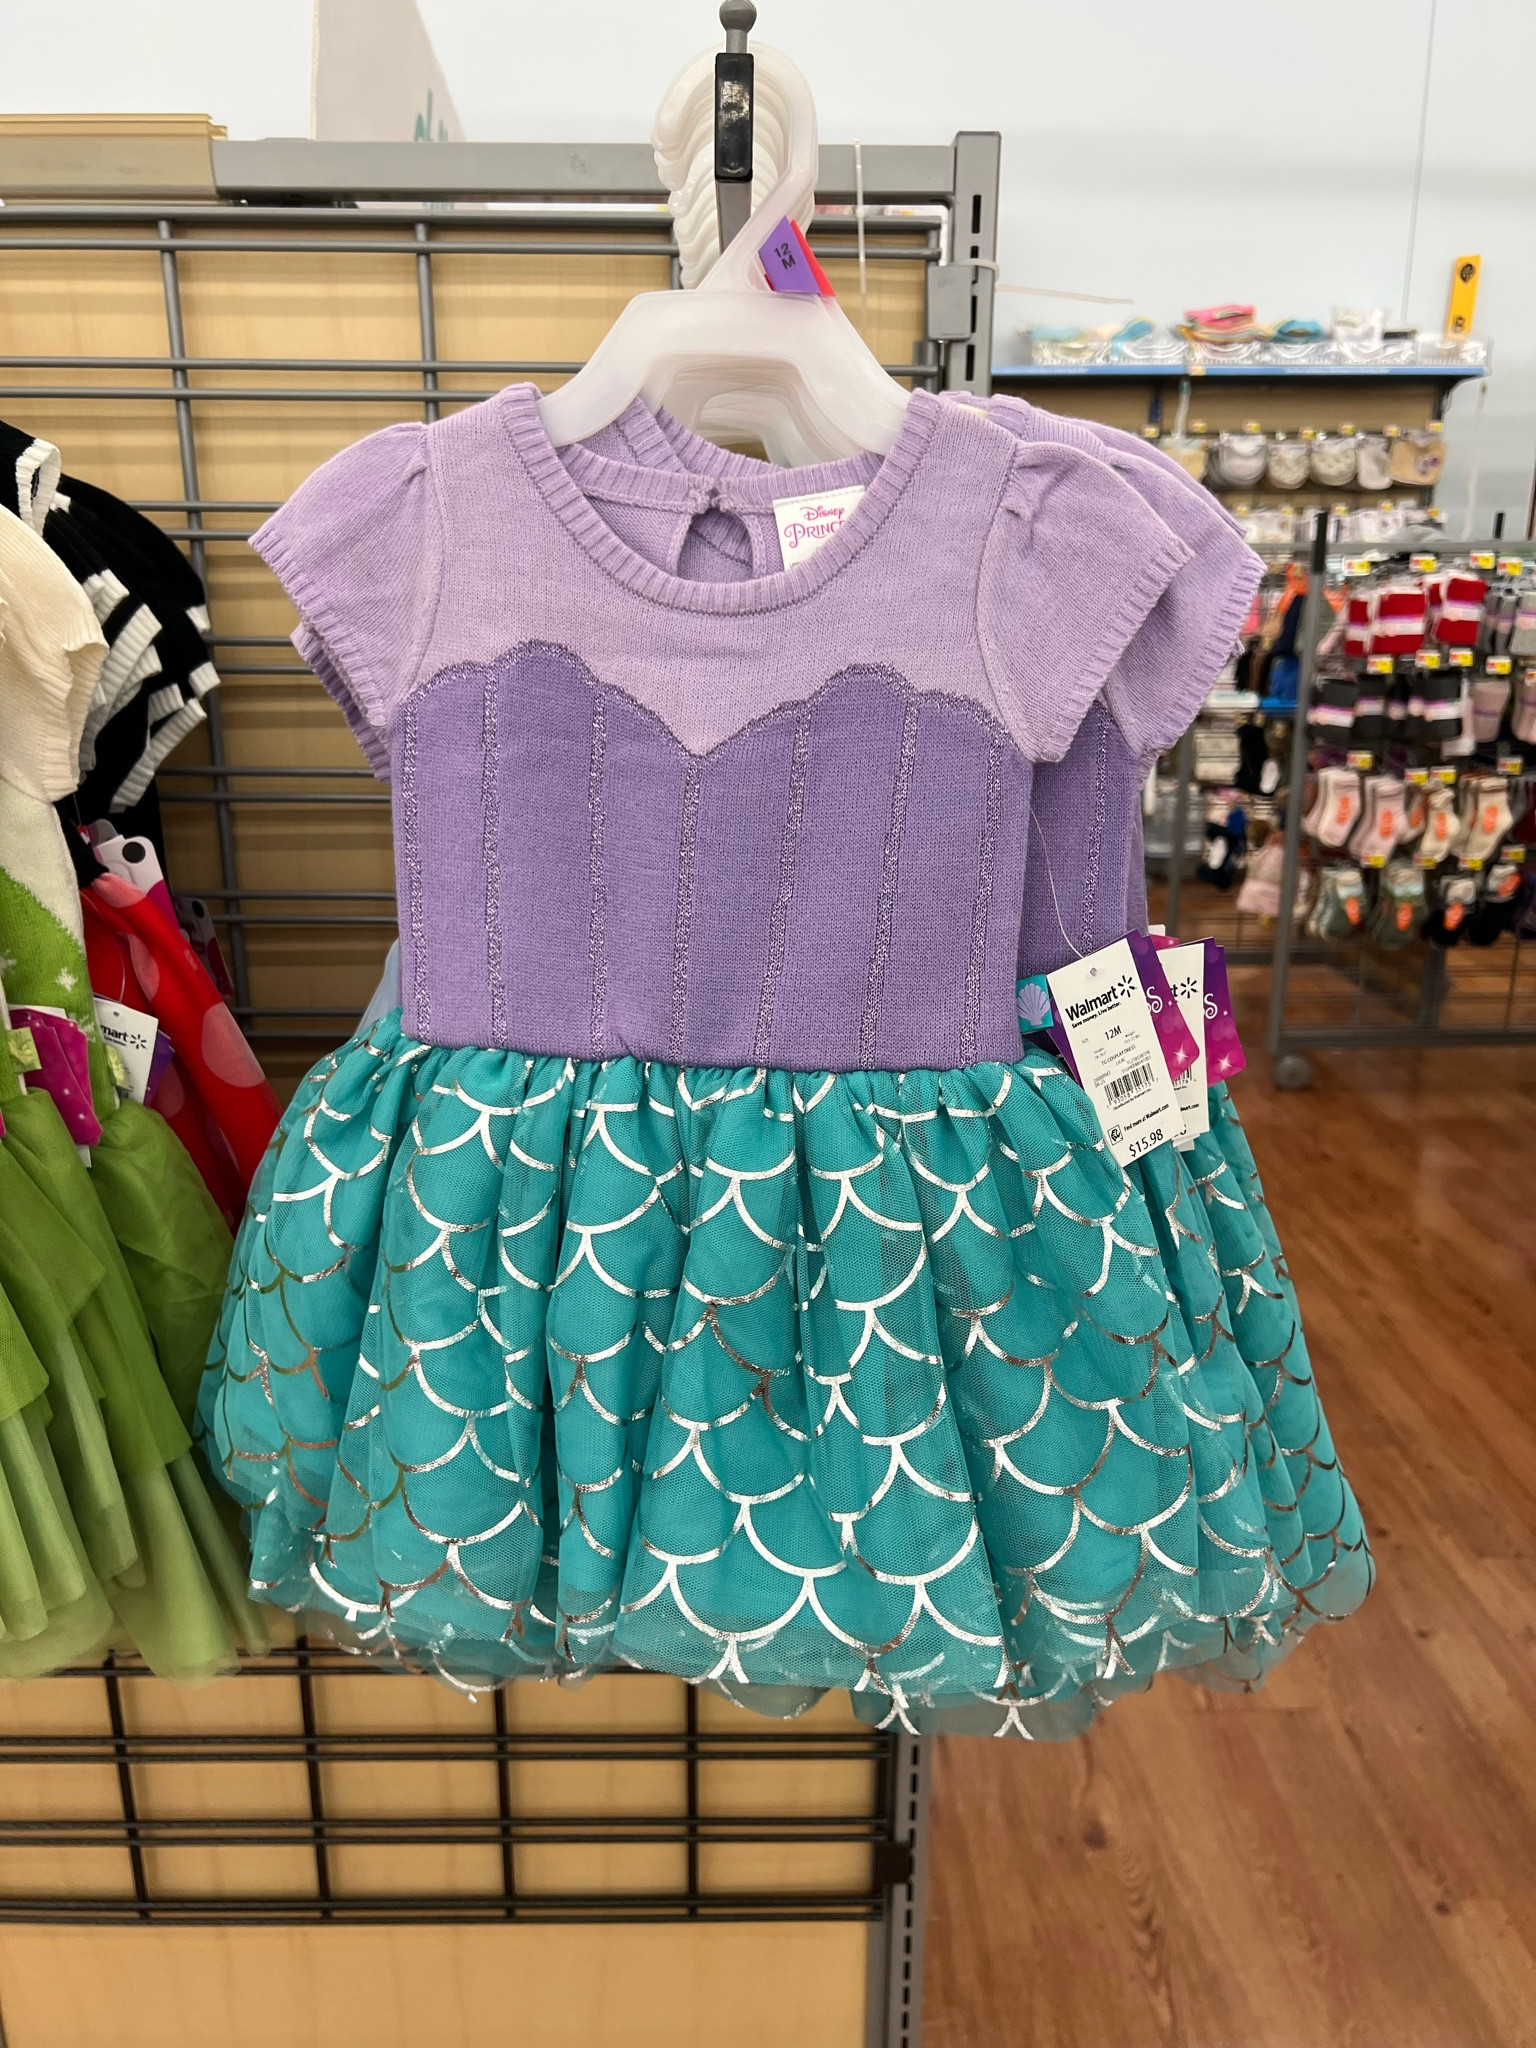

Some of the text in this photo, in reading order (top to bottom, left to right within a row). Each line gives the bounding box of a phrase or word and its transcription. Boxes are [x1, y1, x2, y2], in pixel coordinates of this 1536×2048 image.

[773, 242, 791, 258] 12
[781, 254, 796, 270] M
[800, 505, 845, 521] Disney
[783, 520, 846, 549] PRINC
[1064, 985, 1119, 1022] Walmart
[100, 1024, 128, 1042] mart
[1104, 1024, 1122, 1041] 12M
[1128, 1128, 1164, 1158] $15.98
